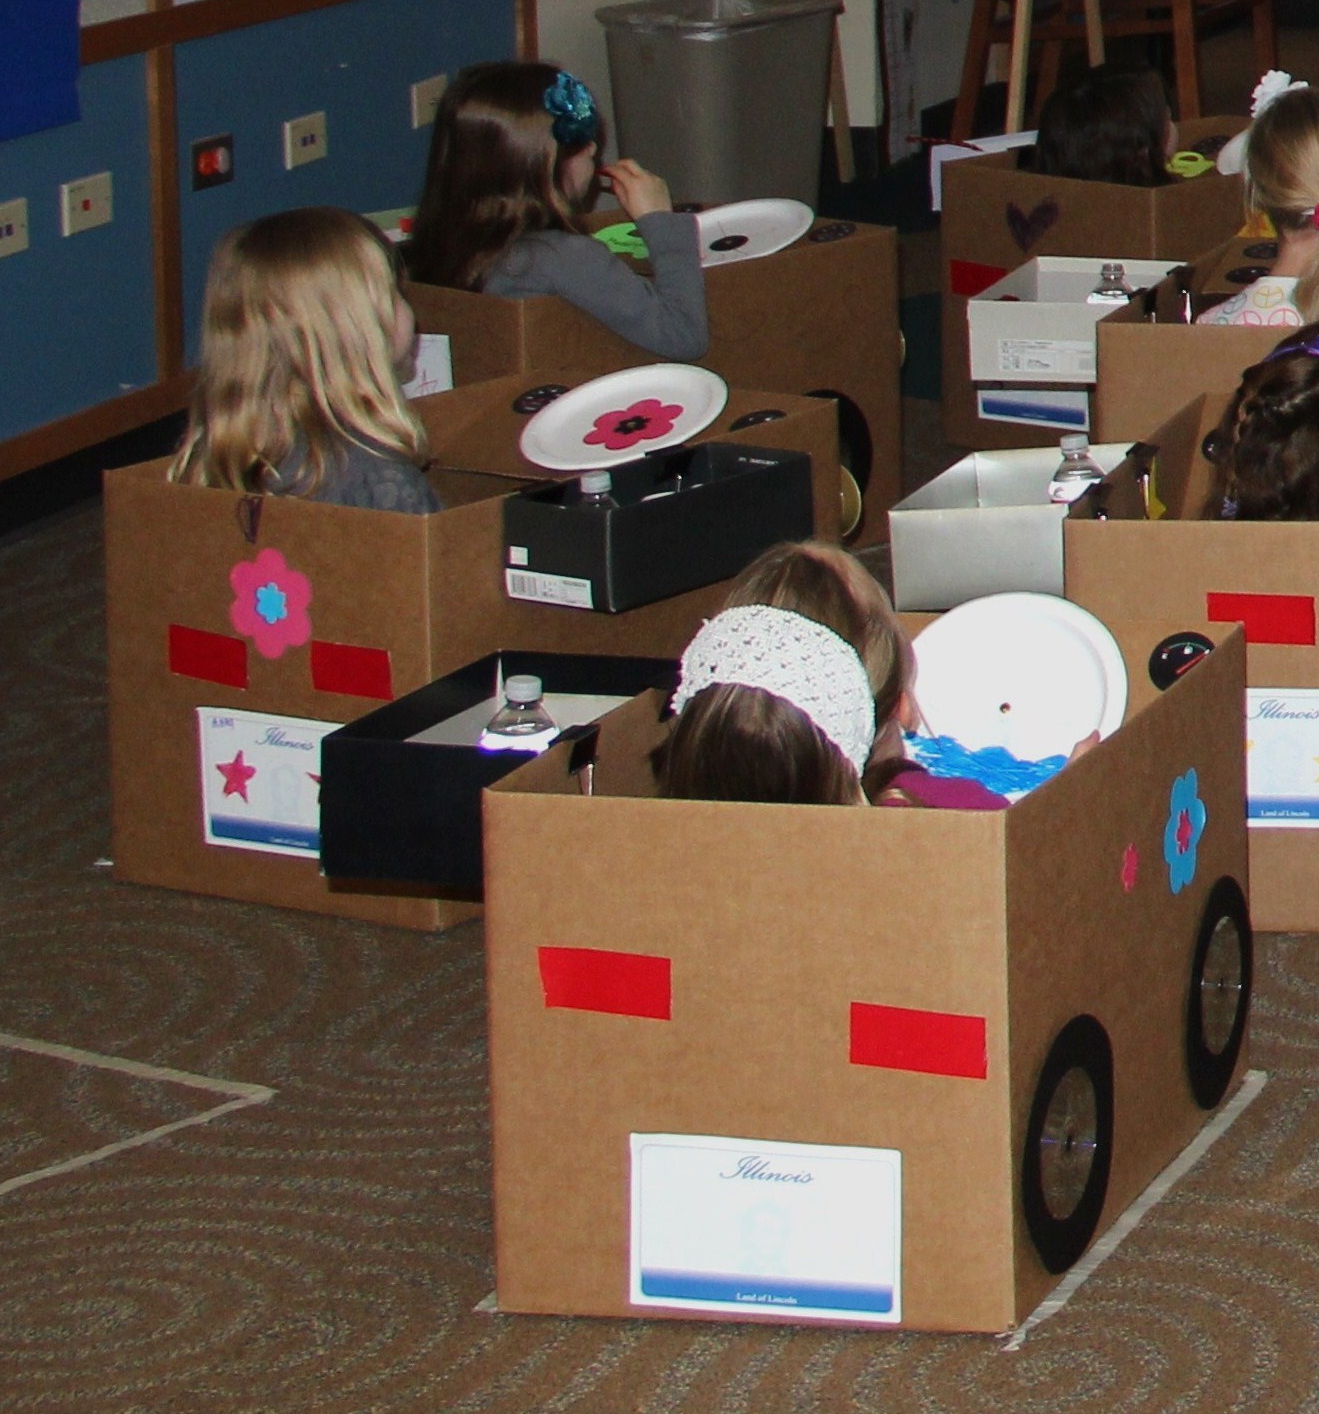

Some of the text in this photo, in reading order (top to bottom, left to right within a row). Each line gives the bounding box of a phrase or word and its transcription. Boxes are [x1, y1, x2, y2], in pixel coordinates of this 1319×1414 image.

[255, 726, 315, 751] Illinois
[719, 1155, 815, 1184] Illinois
[736, 1292, 757, 1302] Land
[767, 1294, 798, 1305] Lincoln
